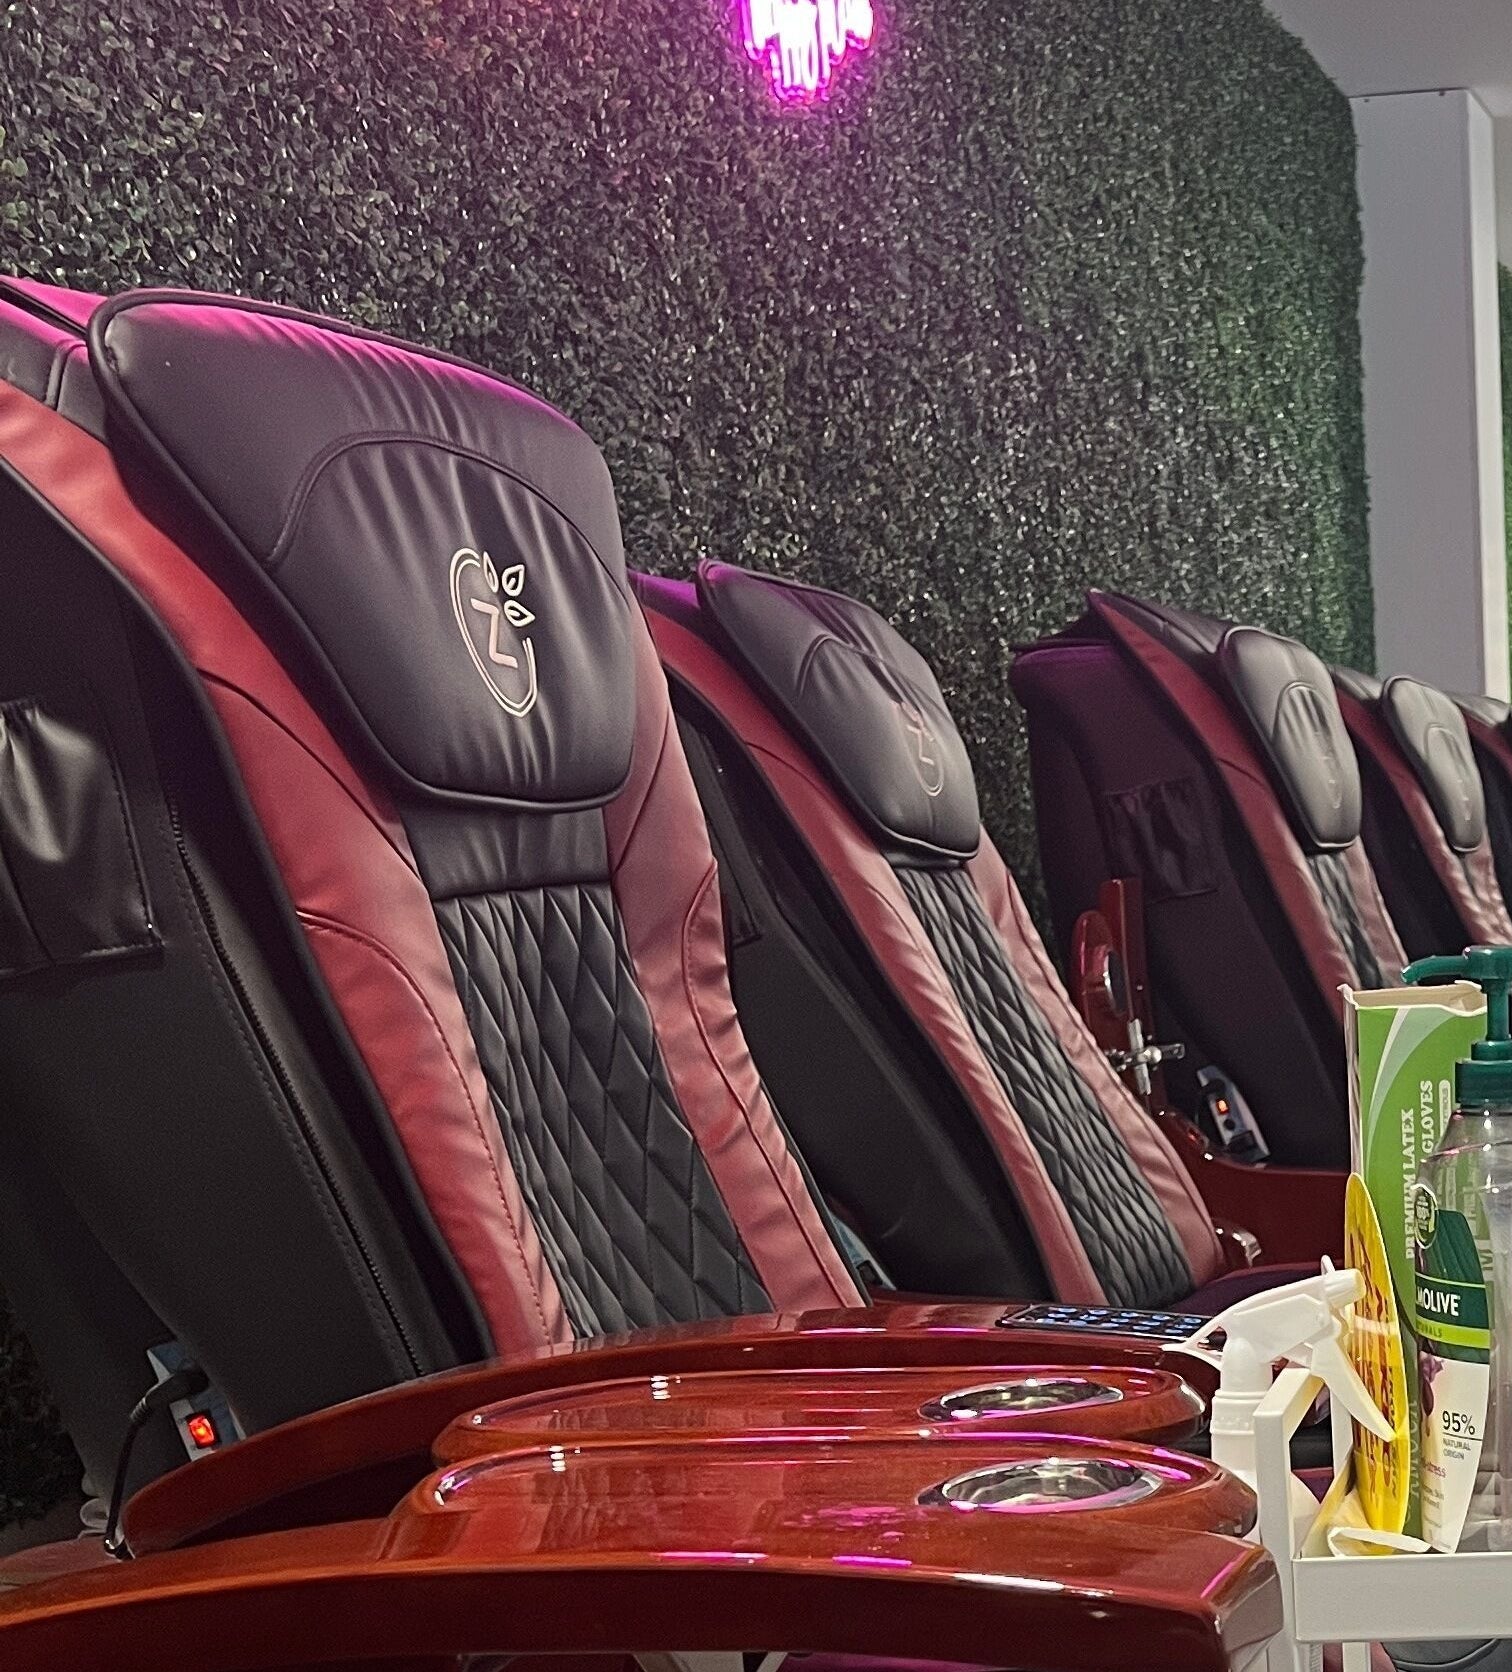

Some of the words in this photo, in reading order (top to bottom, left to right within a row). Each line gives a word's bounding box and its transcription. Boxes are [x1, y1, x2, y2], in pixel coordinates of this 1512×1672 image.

[1420, 1080, 1434, 1154] GLOVES
[1402, 1108, 1416, 1171] LATEX
[1403, 1175, 1416, 1259] PREMIUM
[1442, 1410, 1476, 1436] 95%
[1443, 1438, 1471, 1451] NATURAL
[1443, 1449, 1465, 1460] ORIGIN
